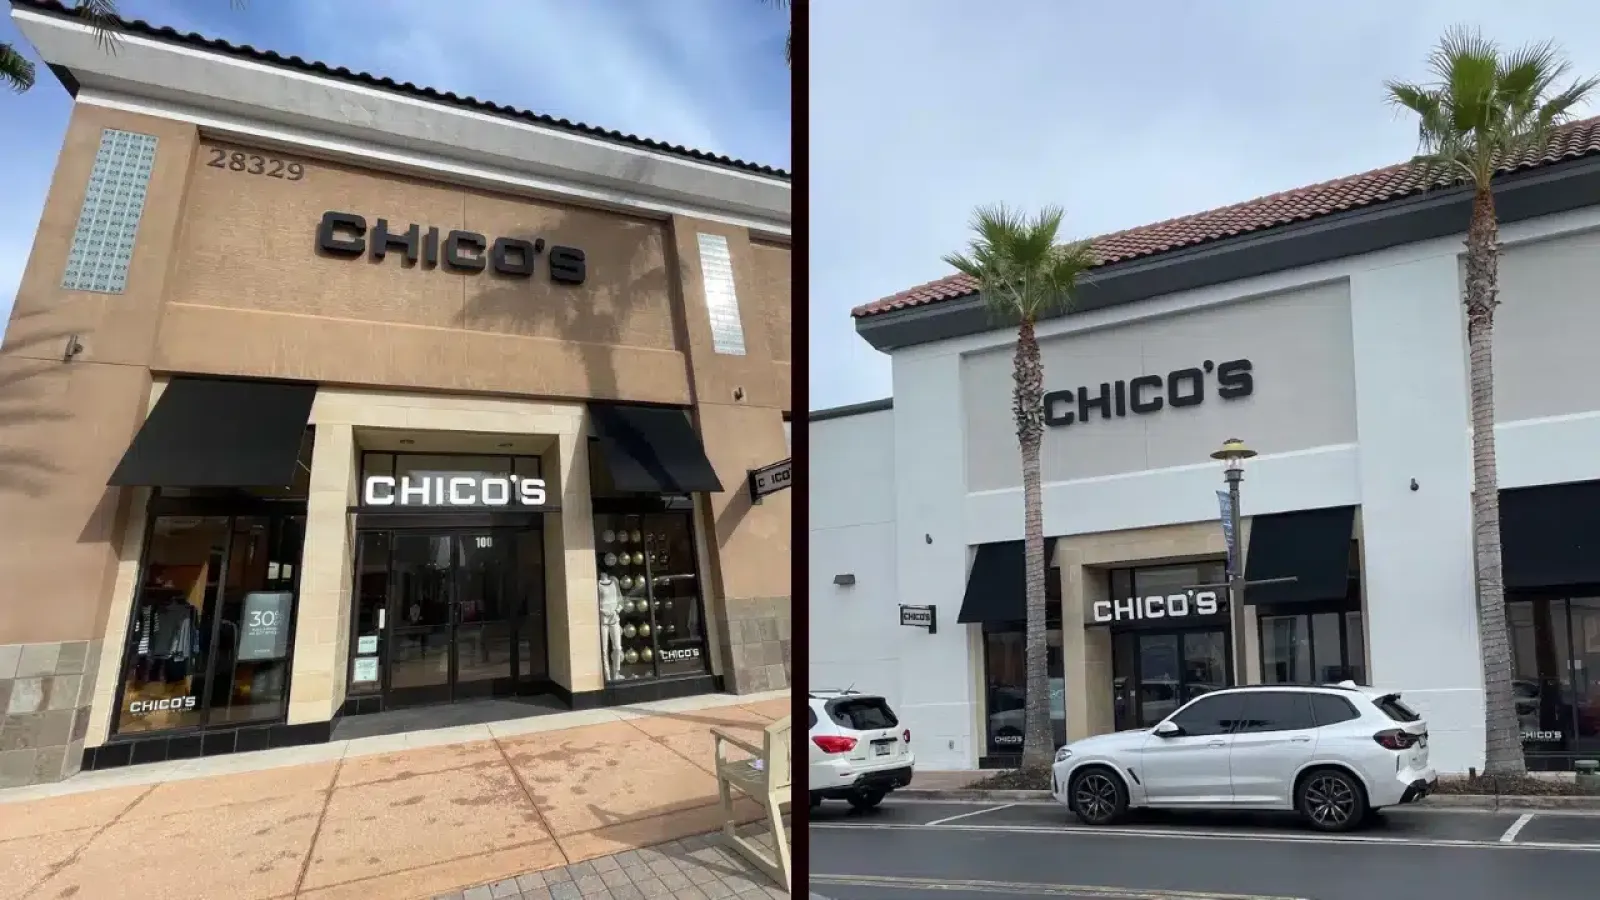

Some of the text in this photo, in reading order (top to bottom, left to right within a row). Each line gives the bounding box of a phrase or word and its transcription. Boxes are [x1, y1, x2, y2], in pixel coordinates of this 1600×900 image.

[206, 148, 305, 181] 28329
[317, 210, 587, 285] CHICO'S
[1043, 358, 1253, 427] CHICO'S
[365, 474, 546, 506] CHICO'S
[475, 536, 493, 548] 100
[903, 612, 931, 621] CHICO'S
[1093, 589, 1218, 622] CHICO'S
[660, 648, 700, 660] CHICO'S
[129, 695, 197, 713] CHICO'S
